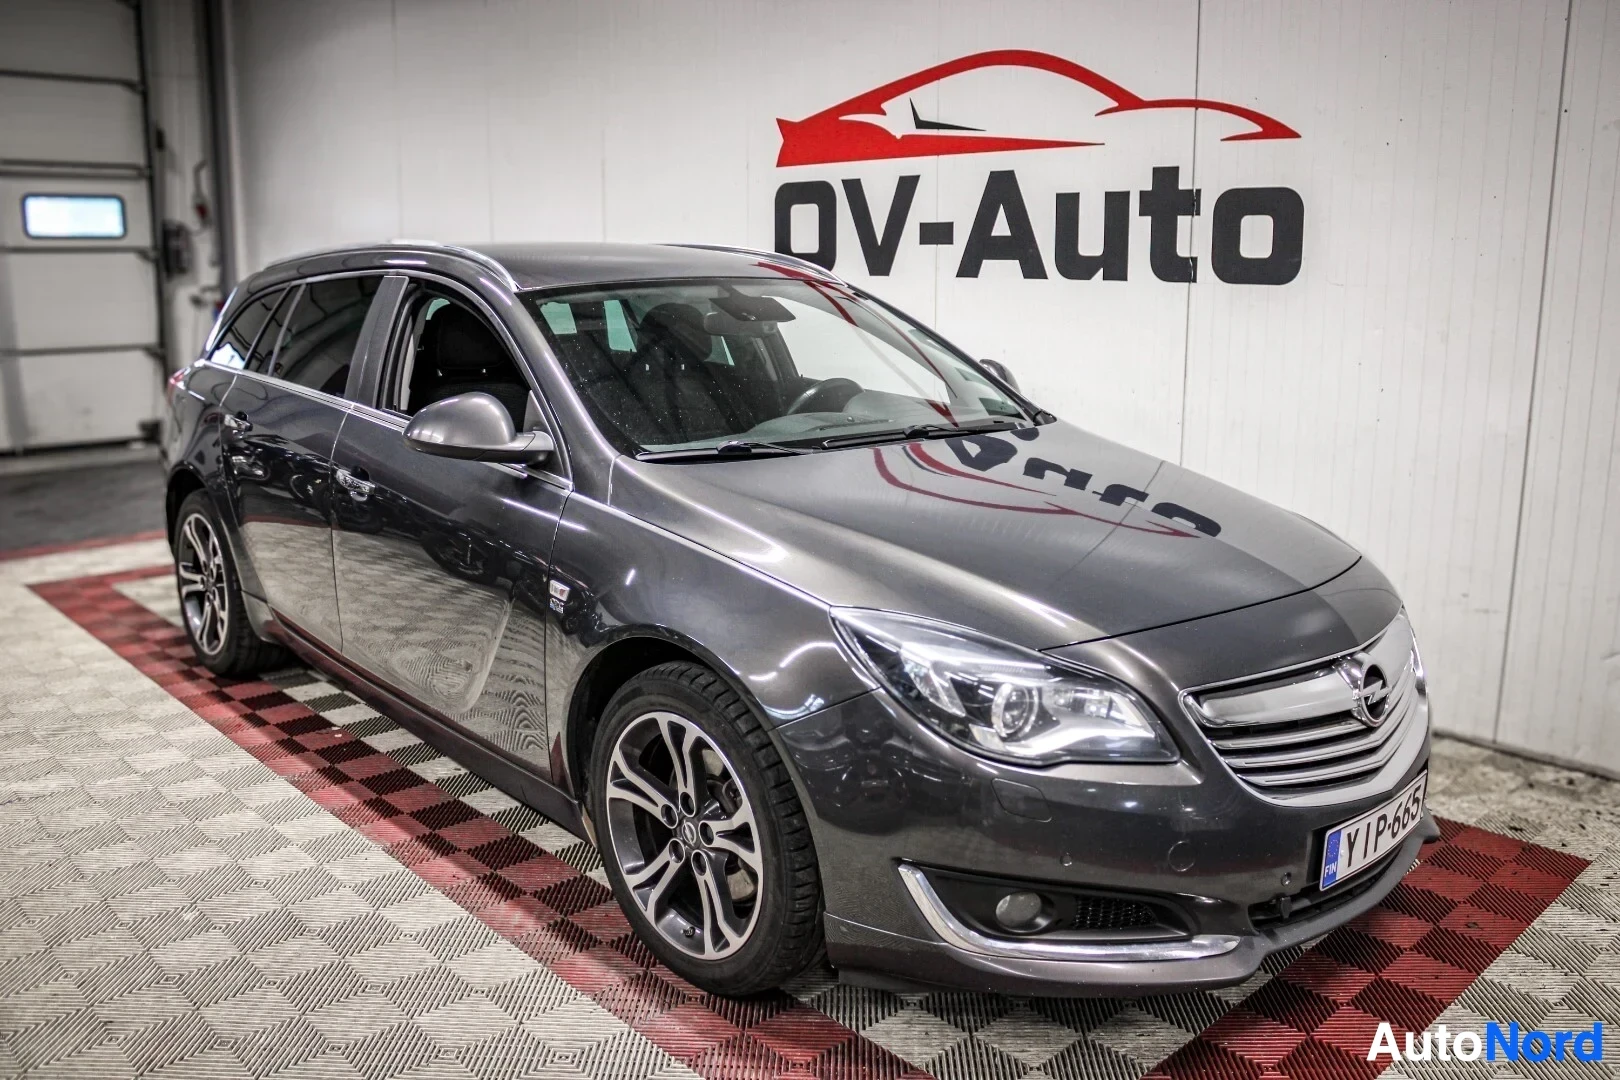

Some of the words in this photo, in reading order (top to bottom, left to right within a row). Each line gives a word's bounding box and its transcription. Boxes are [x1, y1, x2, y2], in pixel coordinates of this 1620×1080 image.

[775, 166, 1304, 285] OV-Auto
[1346, 784, 1422, 868] YIP-665
[1324, 861, 1337, 877] FIN
